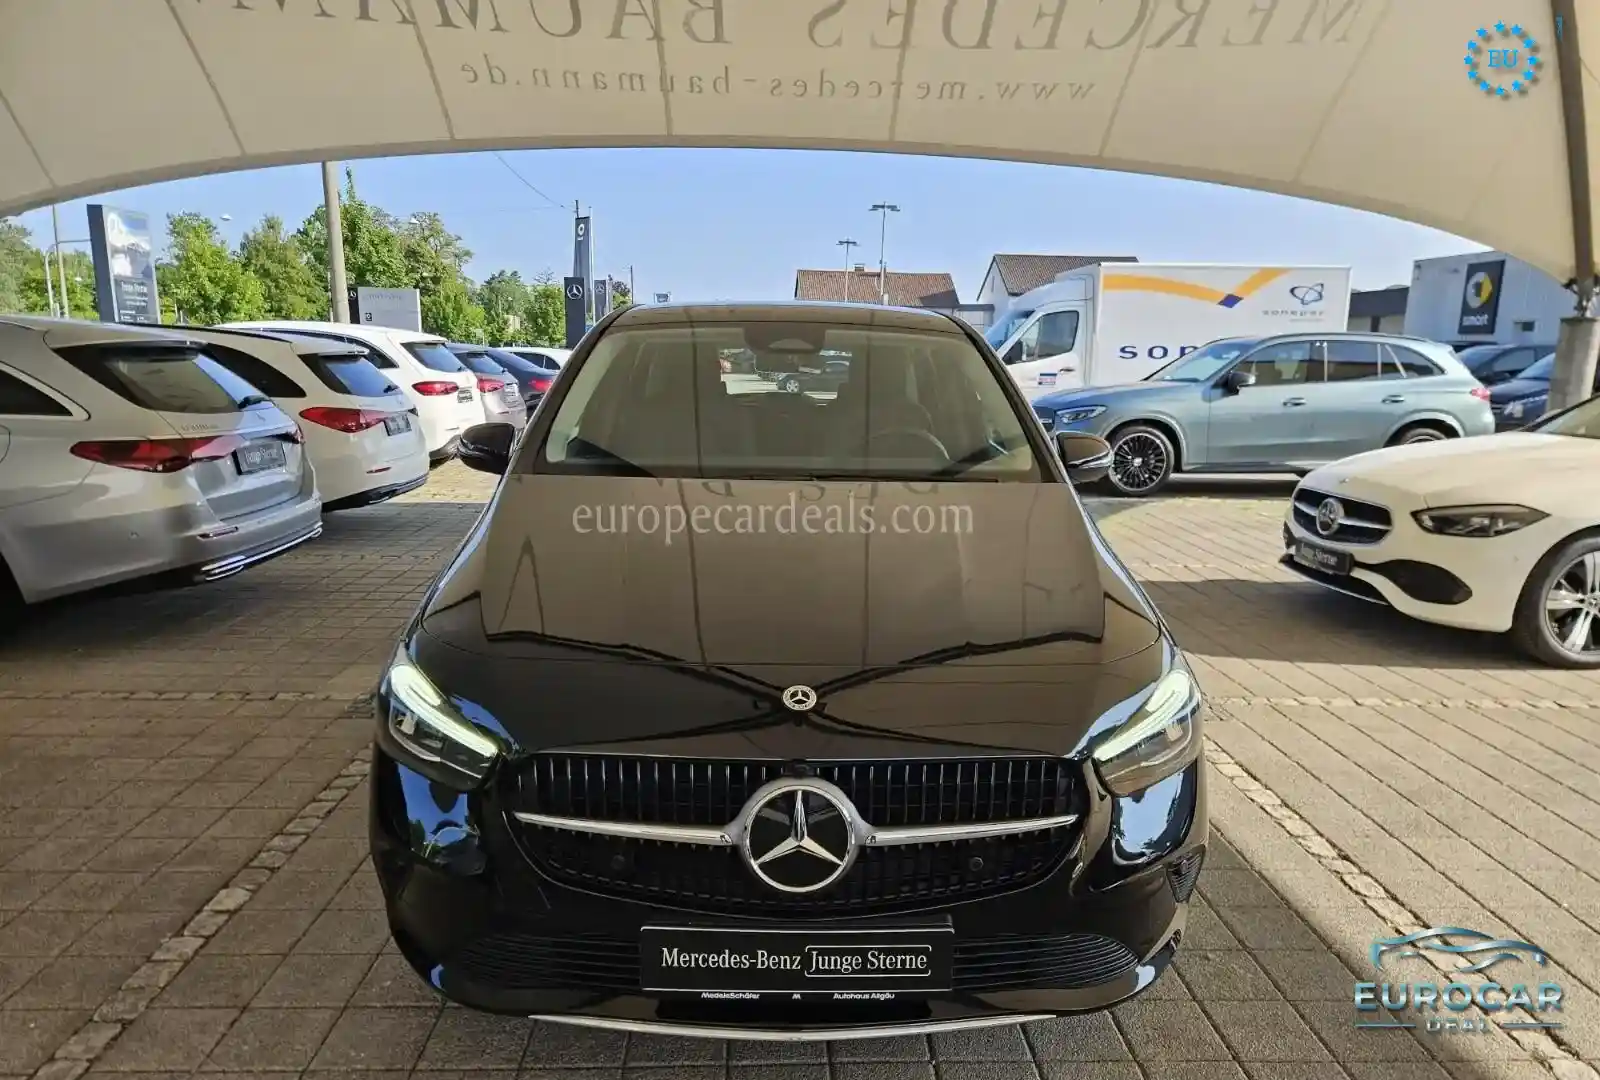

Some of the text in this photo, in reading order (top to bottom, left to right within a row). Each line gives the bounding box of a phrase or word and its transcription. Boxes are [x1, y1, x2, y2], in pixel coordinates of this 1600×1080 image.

[661, 947, 927, 973] Mercedes-Benz Junge Sterne
